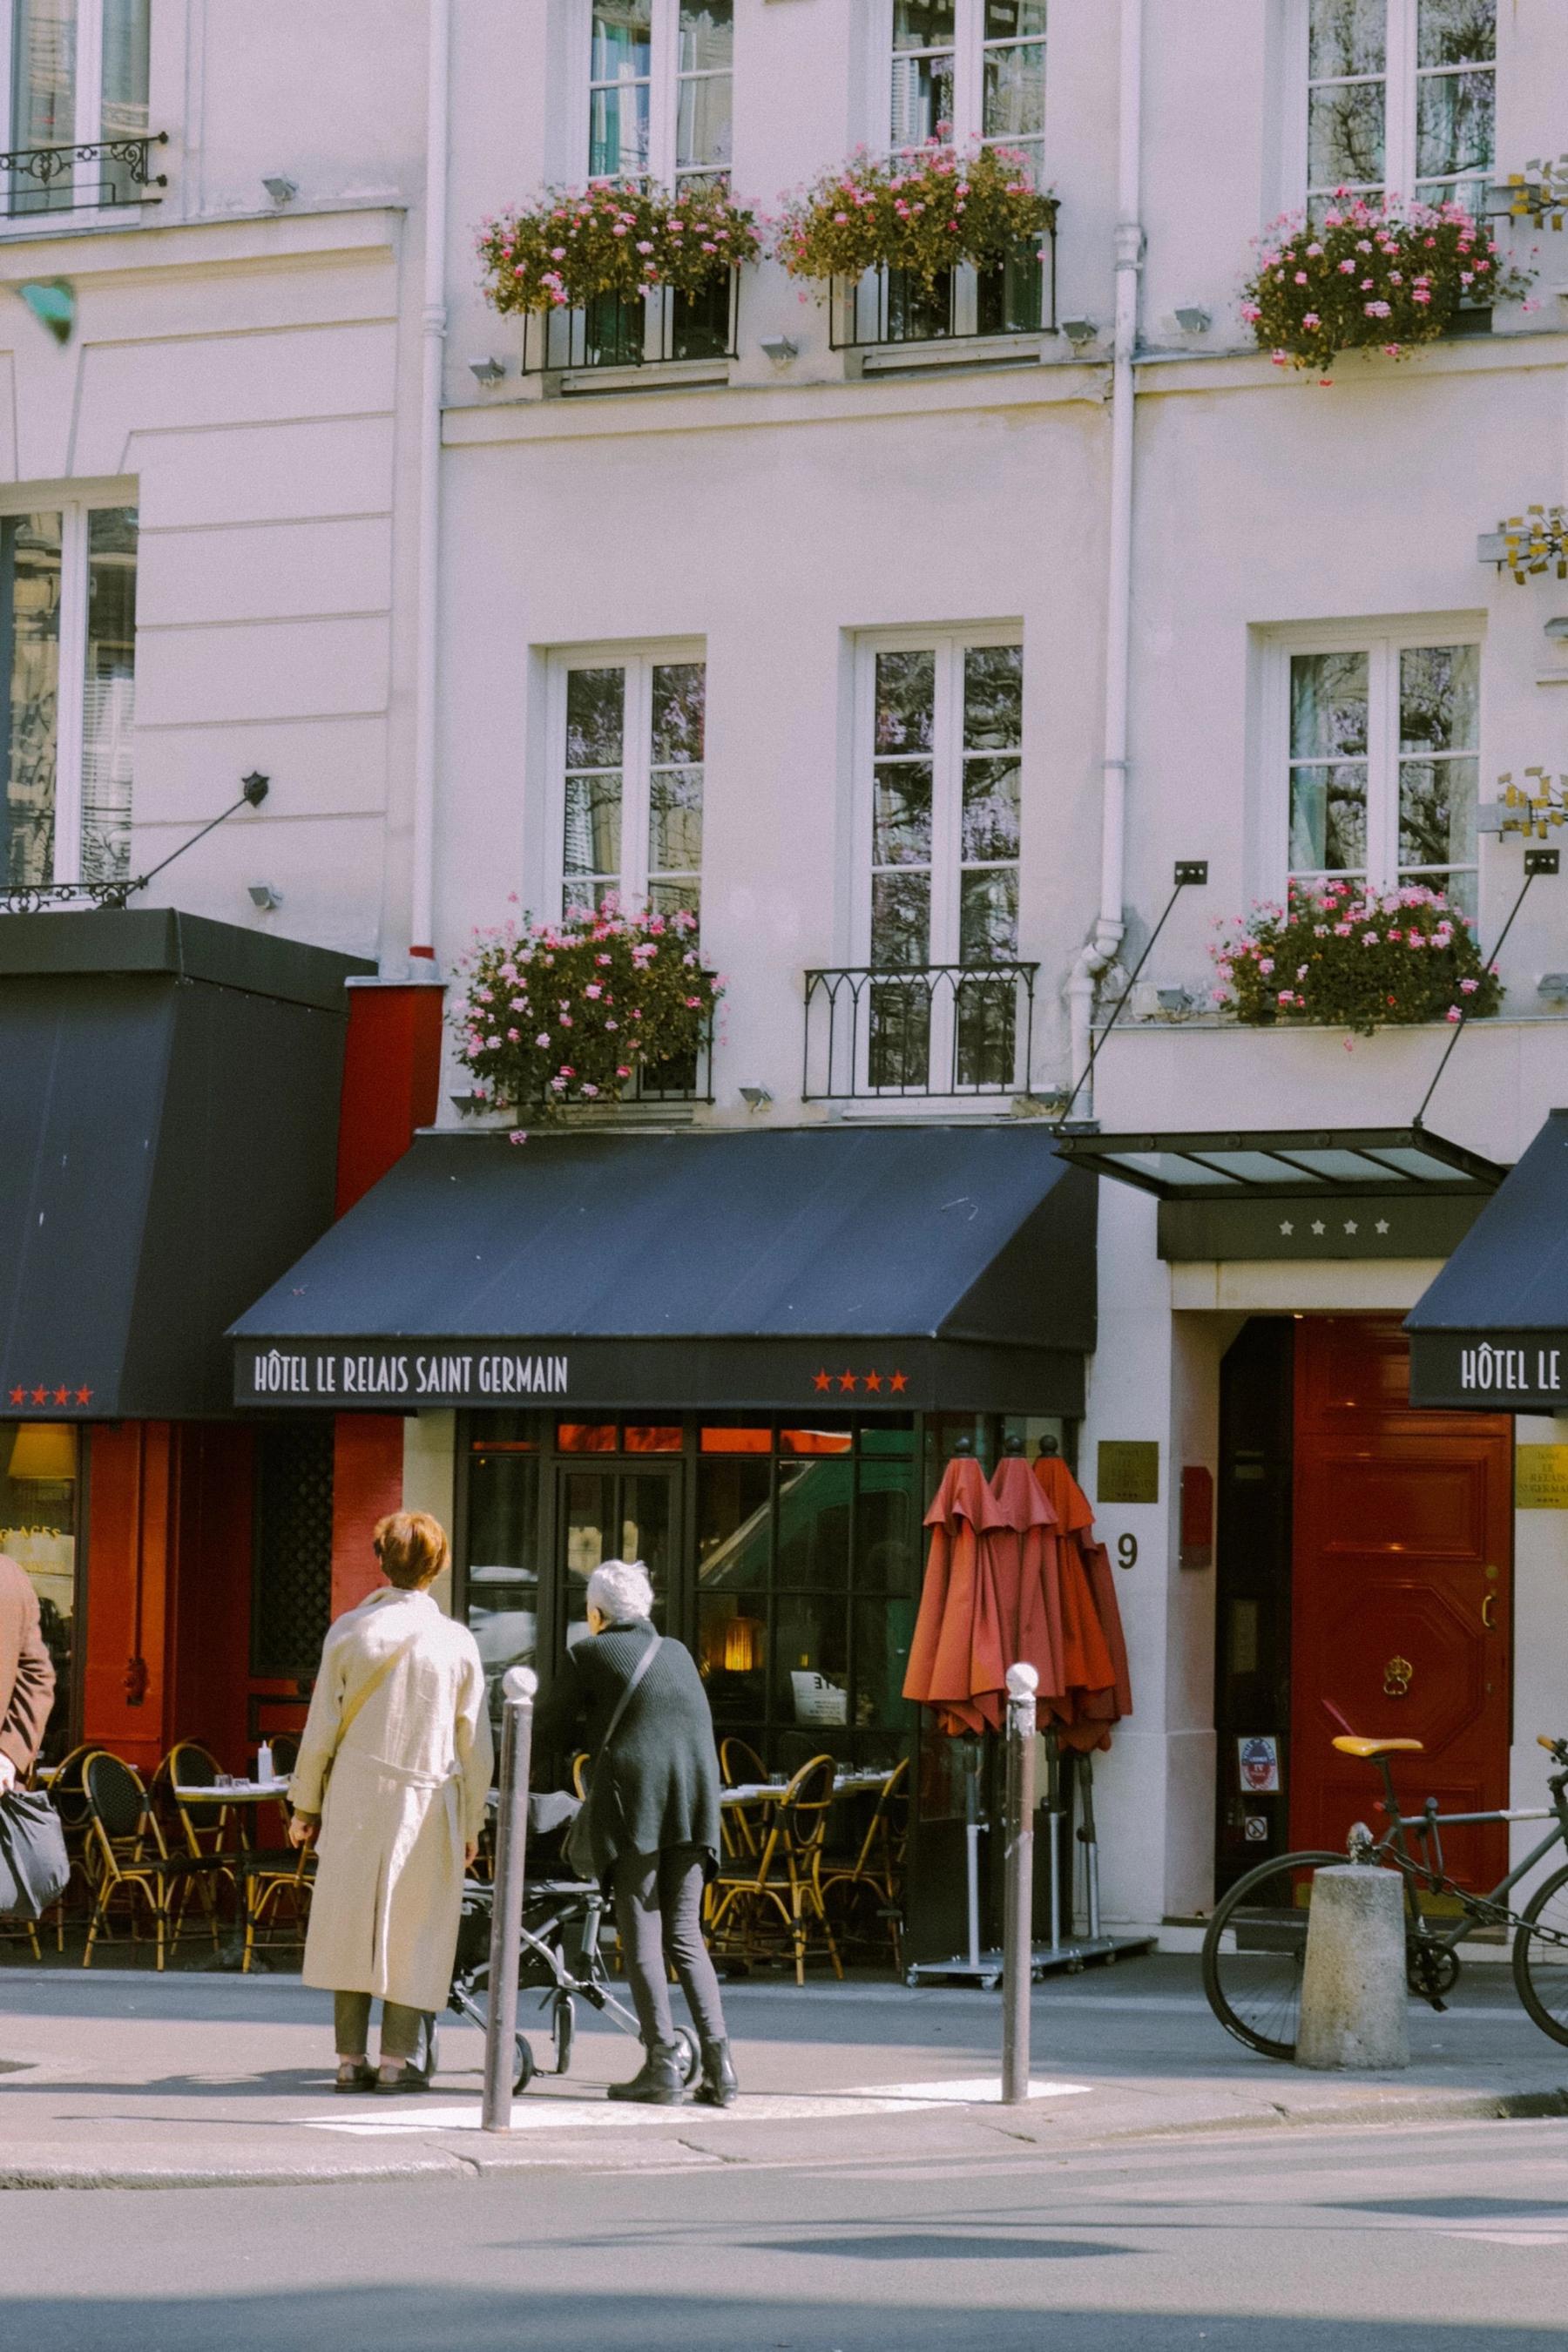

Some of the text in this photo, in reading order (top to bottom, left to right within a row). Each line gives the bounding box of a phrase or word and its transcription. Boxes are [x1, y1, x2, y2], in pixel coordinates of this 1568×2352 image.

[254, 1348, 567, 1393] HÔTEL LE RELAIS SAINT GERMAIN
[1462, 1342, 1560, 1389] HÔTEL LE
[1118, 1533, 1138, 1570] 9
